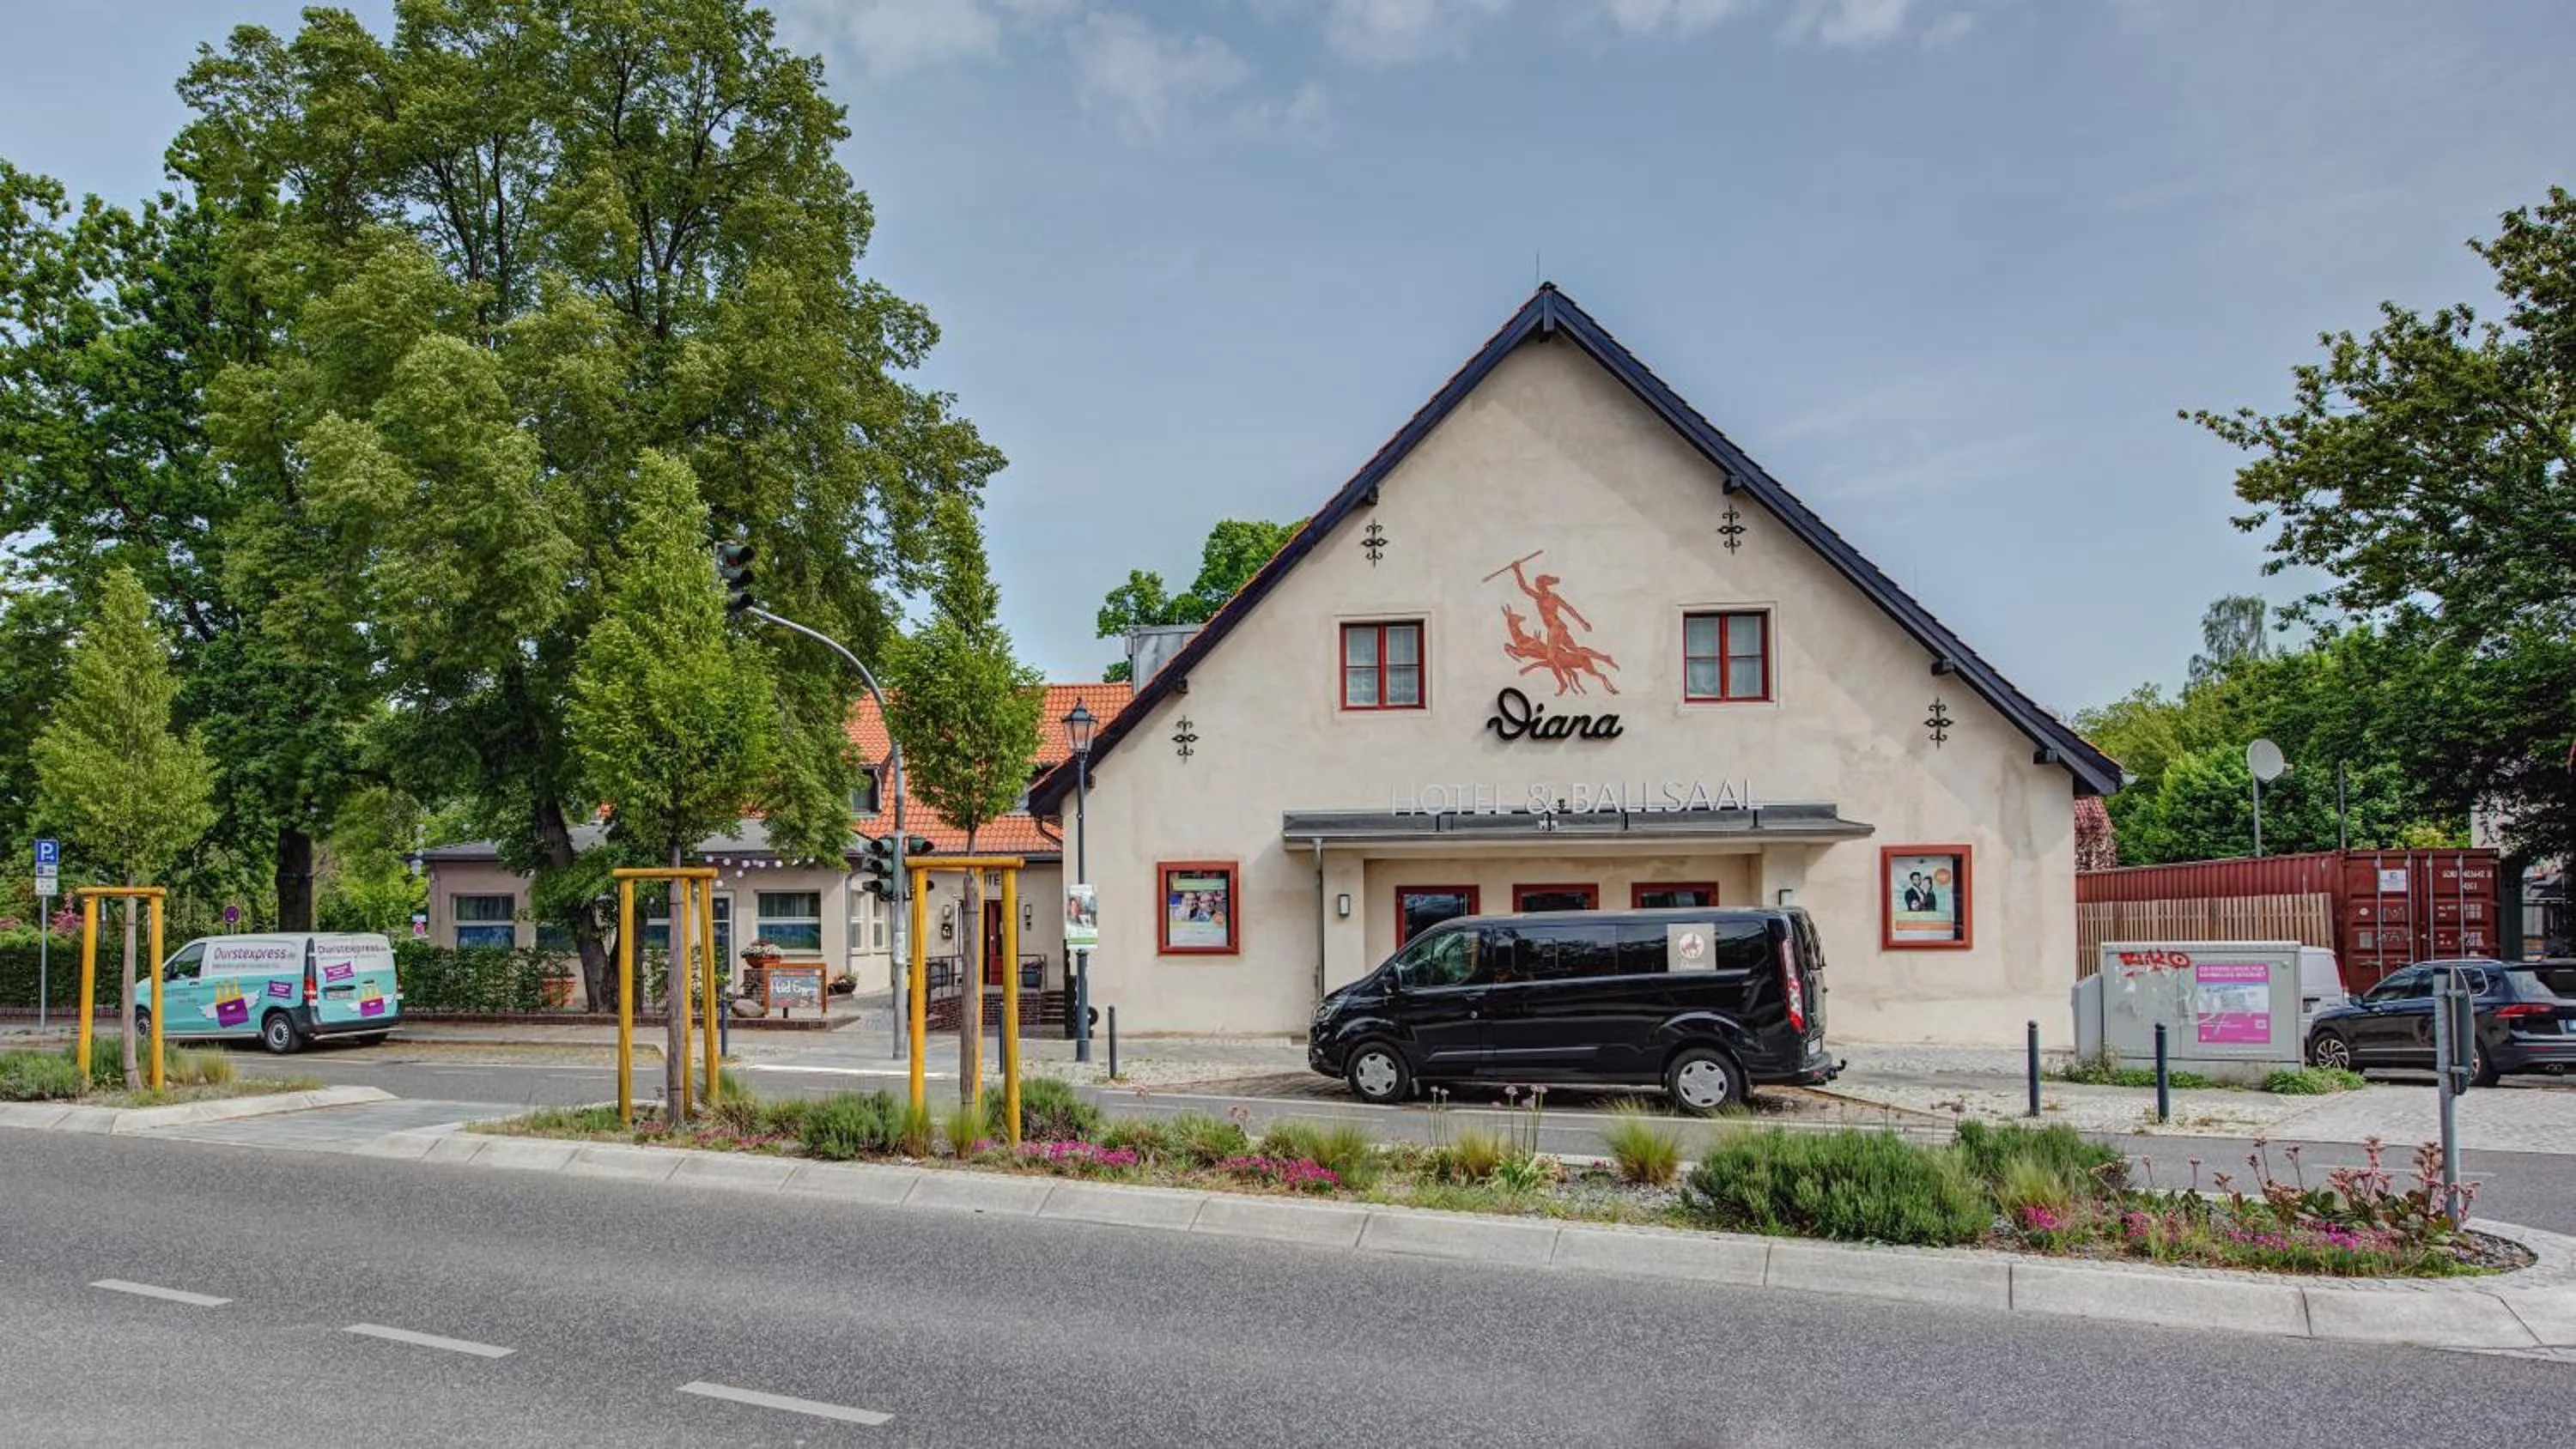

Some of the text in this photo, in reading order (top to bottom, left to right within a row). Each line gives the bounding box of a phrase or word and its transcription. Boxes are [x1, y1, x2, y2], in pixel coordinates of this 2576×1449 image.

[1486, 687, 1624, 740] Diana
[1391, 778, 1764, 815] HOTEL & BALLSAAL
[40, 843, 53, 861] P
